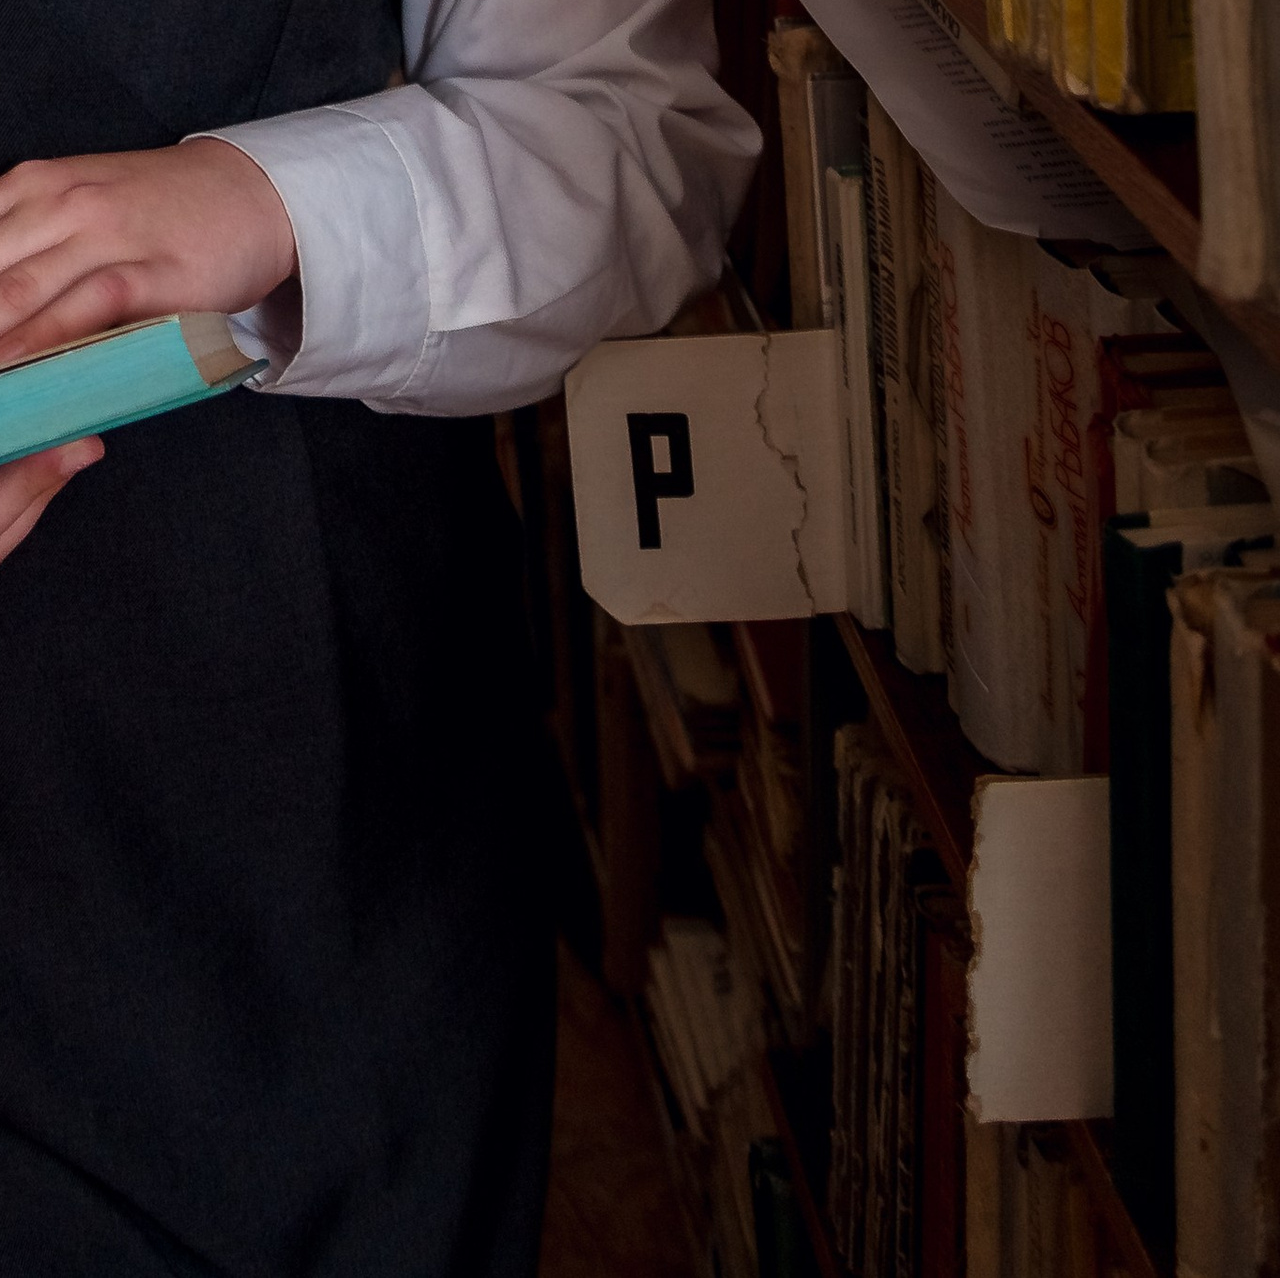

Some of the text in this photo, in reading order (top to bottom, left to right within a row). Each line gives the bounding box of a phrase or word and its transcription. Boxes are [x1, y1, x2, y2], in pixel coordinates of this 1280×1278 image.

[879, 262, 900, 385] ПАШКИНЫ
[1040, 310, 1085, 502] РЫБАКОВ
[626, 410, 696, 551] Р
[892, 496, 907, 595] АРСЕНИЙ
